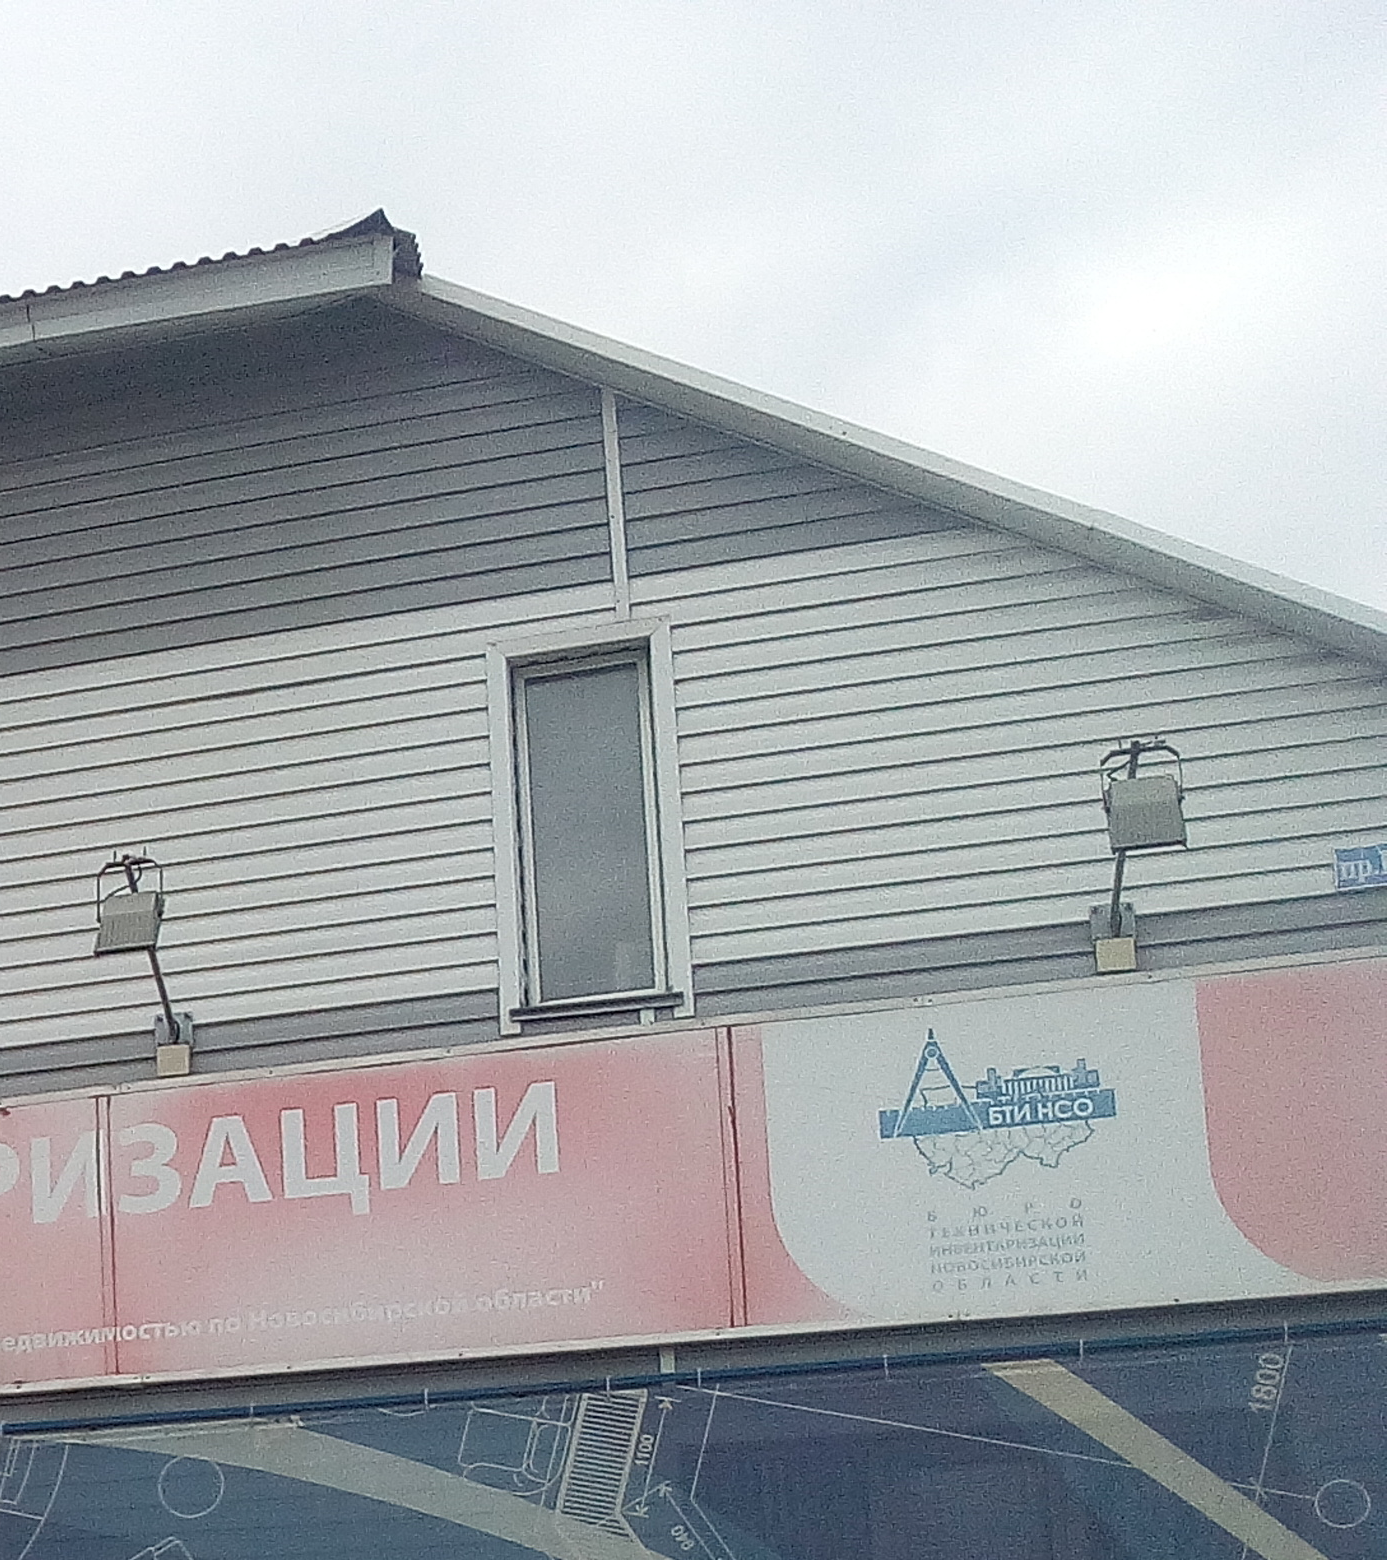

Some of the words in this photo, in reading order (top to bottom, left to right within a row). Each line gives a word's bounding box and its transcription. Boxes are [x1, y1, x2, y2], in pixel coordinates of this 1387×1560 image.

[988, 1104, 1031, 1125] БТИ
[1037, 1098, 1094, 1120] НСО
[1249, 1353, 1284, 1414] 1800
